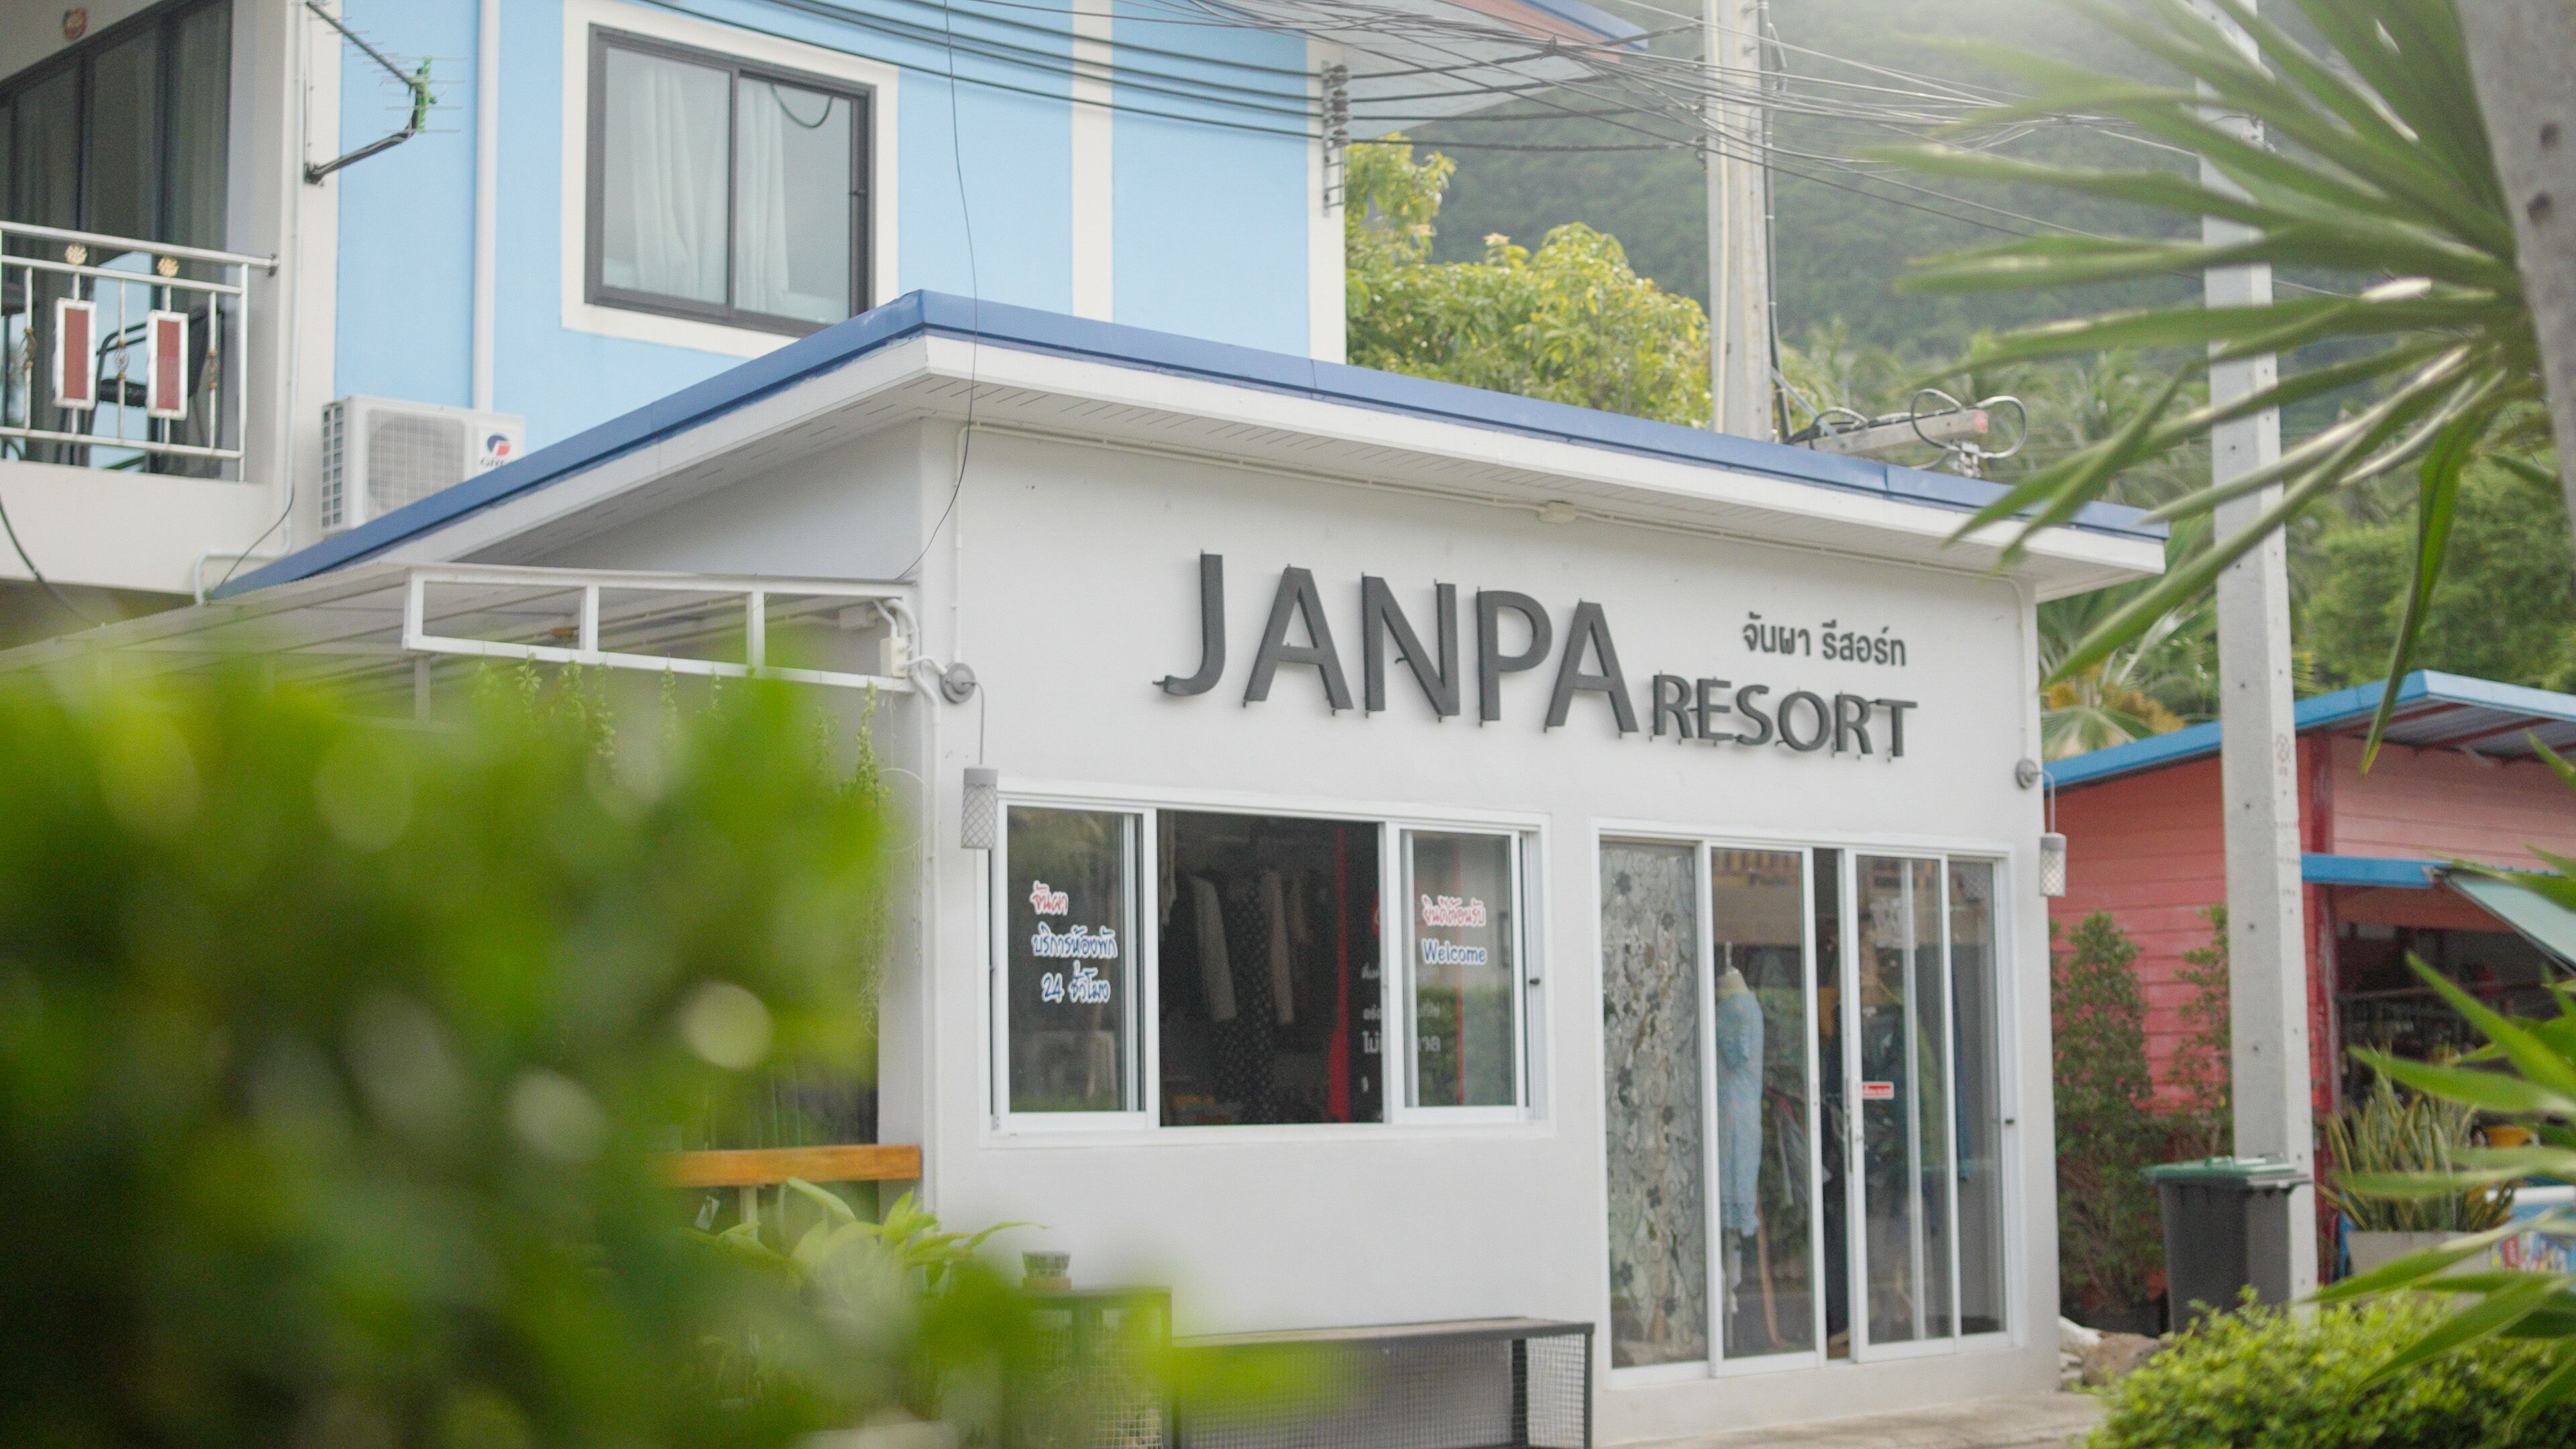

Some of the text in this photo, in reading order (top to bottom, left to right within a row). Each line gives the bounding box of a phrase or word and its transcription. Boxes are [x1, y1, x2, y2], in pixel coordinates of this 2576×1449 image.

[1162, 551, 1918, 757] JANPA RESORT
[1743, 611, 1906, 667] จันผา รีสอร์ท
[1421, 938, 1487, 965] Welcome
[1042, 961, 1111, 1003] 24 ชั่วโมง
